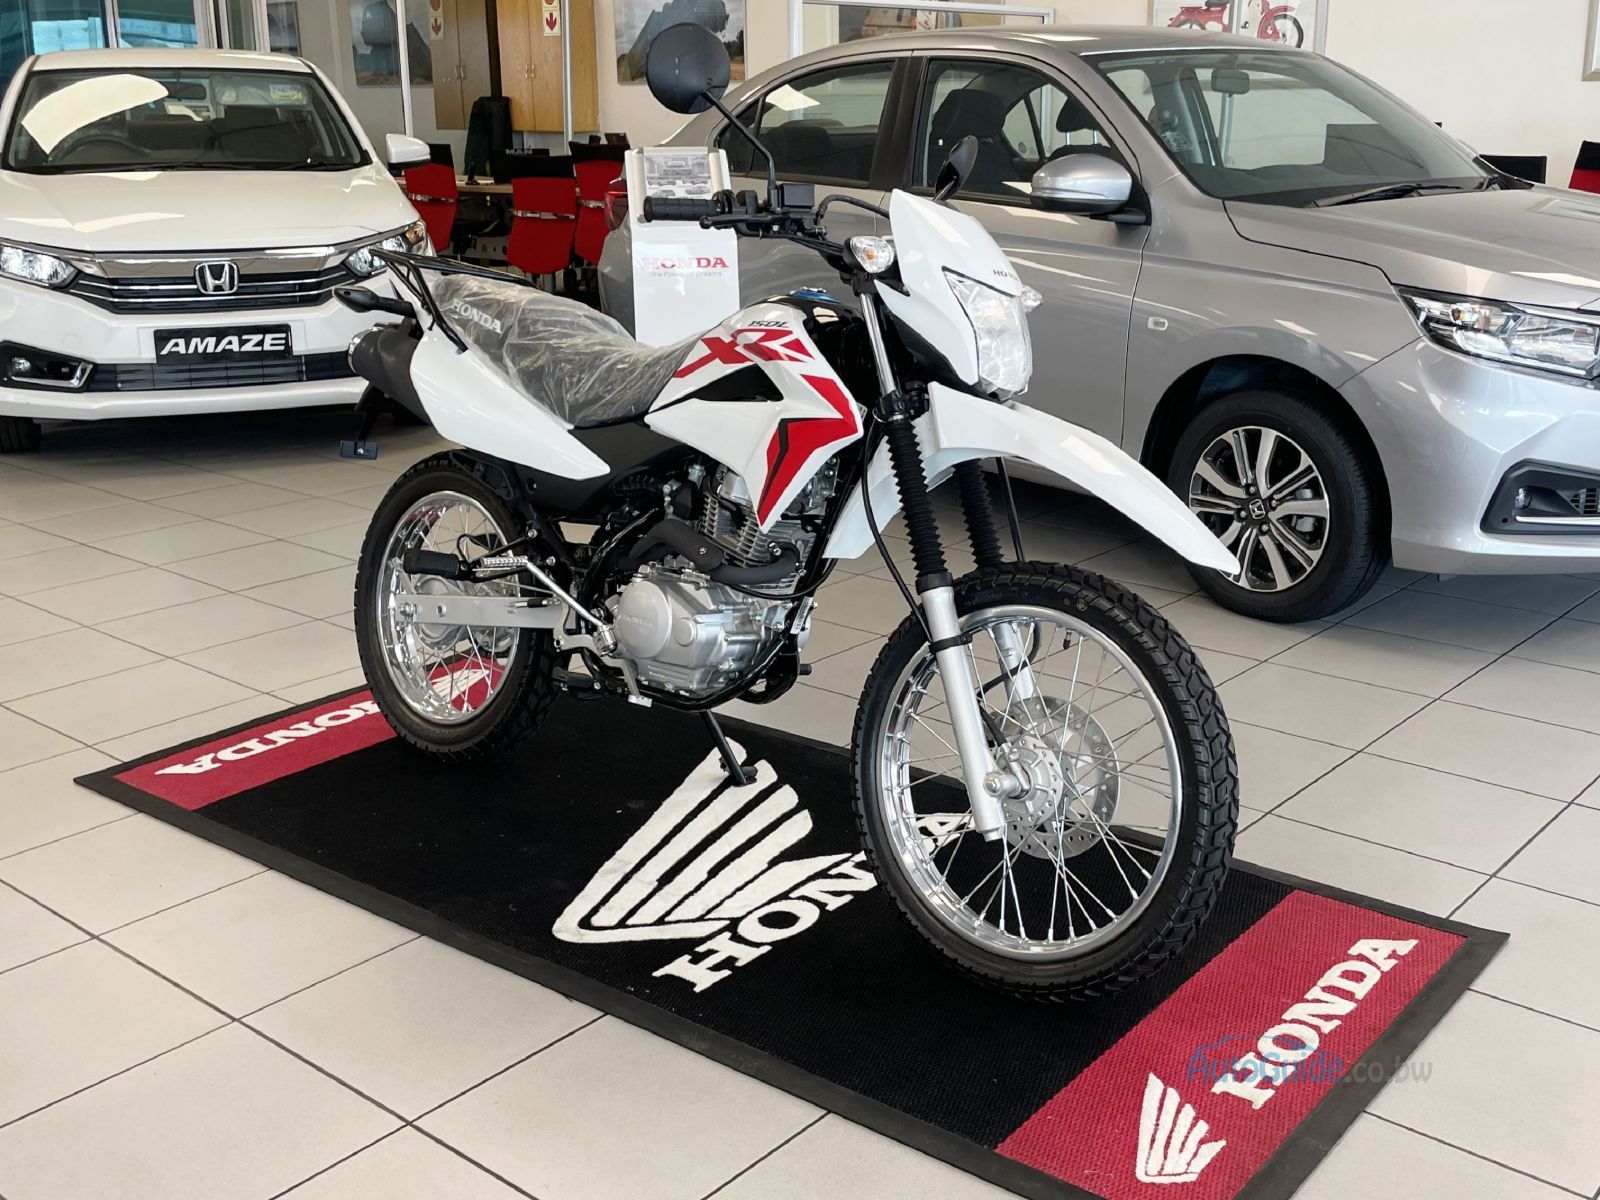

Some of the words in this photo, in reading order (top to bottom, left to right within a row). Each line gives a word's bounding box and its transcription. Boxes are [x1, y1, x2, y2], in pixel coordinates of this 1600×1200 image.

[451, 298, 502, 334] HONDA
[160, 333, 287, 355] AMAZE
[1211, 939, 1420, 1110] HONDA
